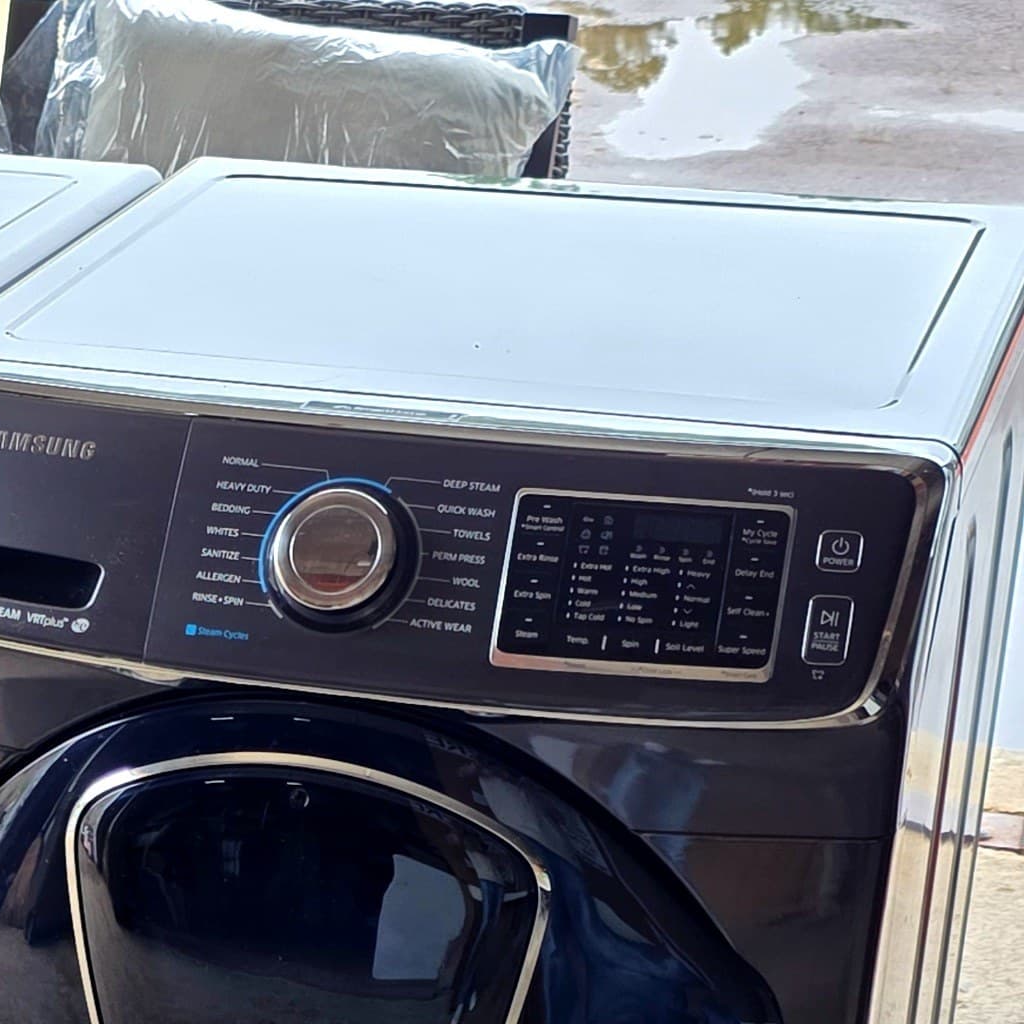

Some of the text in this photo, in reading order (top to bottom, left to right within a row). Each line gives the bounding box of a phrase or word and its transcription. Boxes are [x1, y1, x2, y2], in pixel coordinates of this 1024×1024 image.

[222, 456, 260, 468] NORMAL
[216, 480, 272, 494] HEAVY DUTY
[443, 479, 501, 493] DEEP STEAM
[211, 502, 251, 515] BEDDING
[437, 504, 496, 518] QUICK WASH
[206, 526, 240, 538] WHITES
[453, 528, 491, 542] TOWELS
[742, 528, 778, 538] My Cycle
[200, 548, 240, 561] SANITIZE
[432, 550, 486, 565] PERM PRESS
[516, 552, 538, 562] Extra
[822, 557, 855, 567] POWER
[195, 570, 242, 584] ALLERGEN
[734, 568, 775, 579] Delay End
[452, 577, 480, 588] WOOL
[513, 590, 552, 601] Extra Spin
[427, 597, 476, 611] DELICATES
[727, 607, 742, 615] Self
[409, 618, 472, 634] ACTIVE WEAR
[198, 626, 248, 641] Steam Cycles
[813, 631, 840, 640] START
[665, 642, 705, 652] Soil Level
[718, 645, 766, 656] Super Speed
[811, 642, 839, 652] PAUSE
